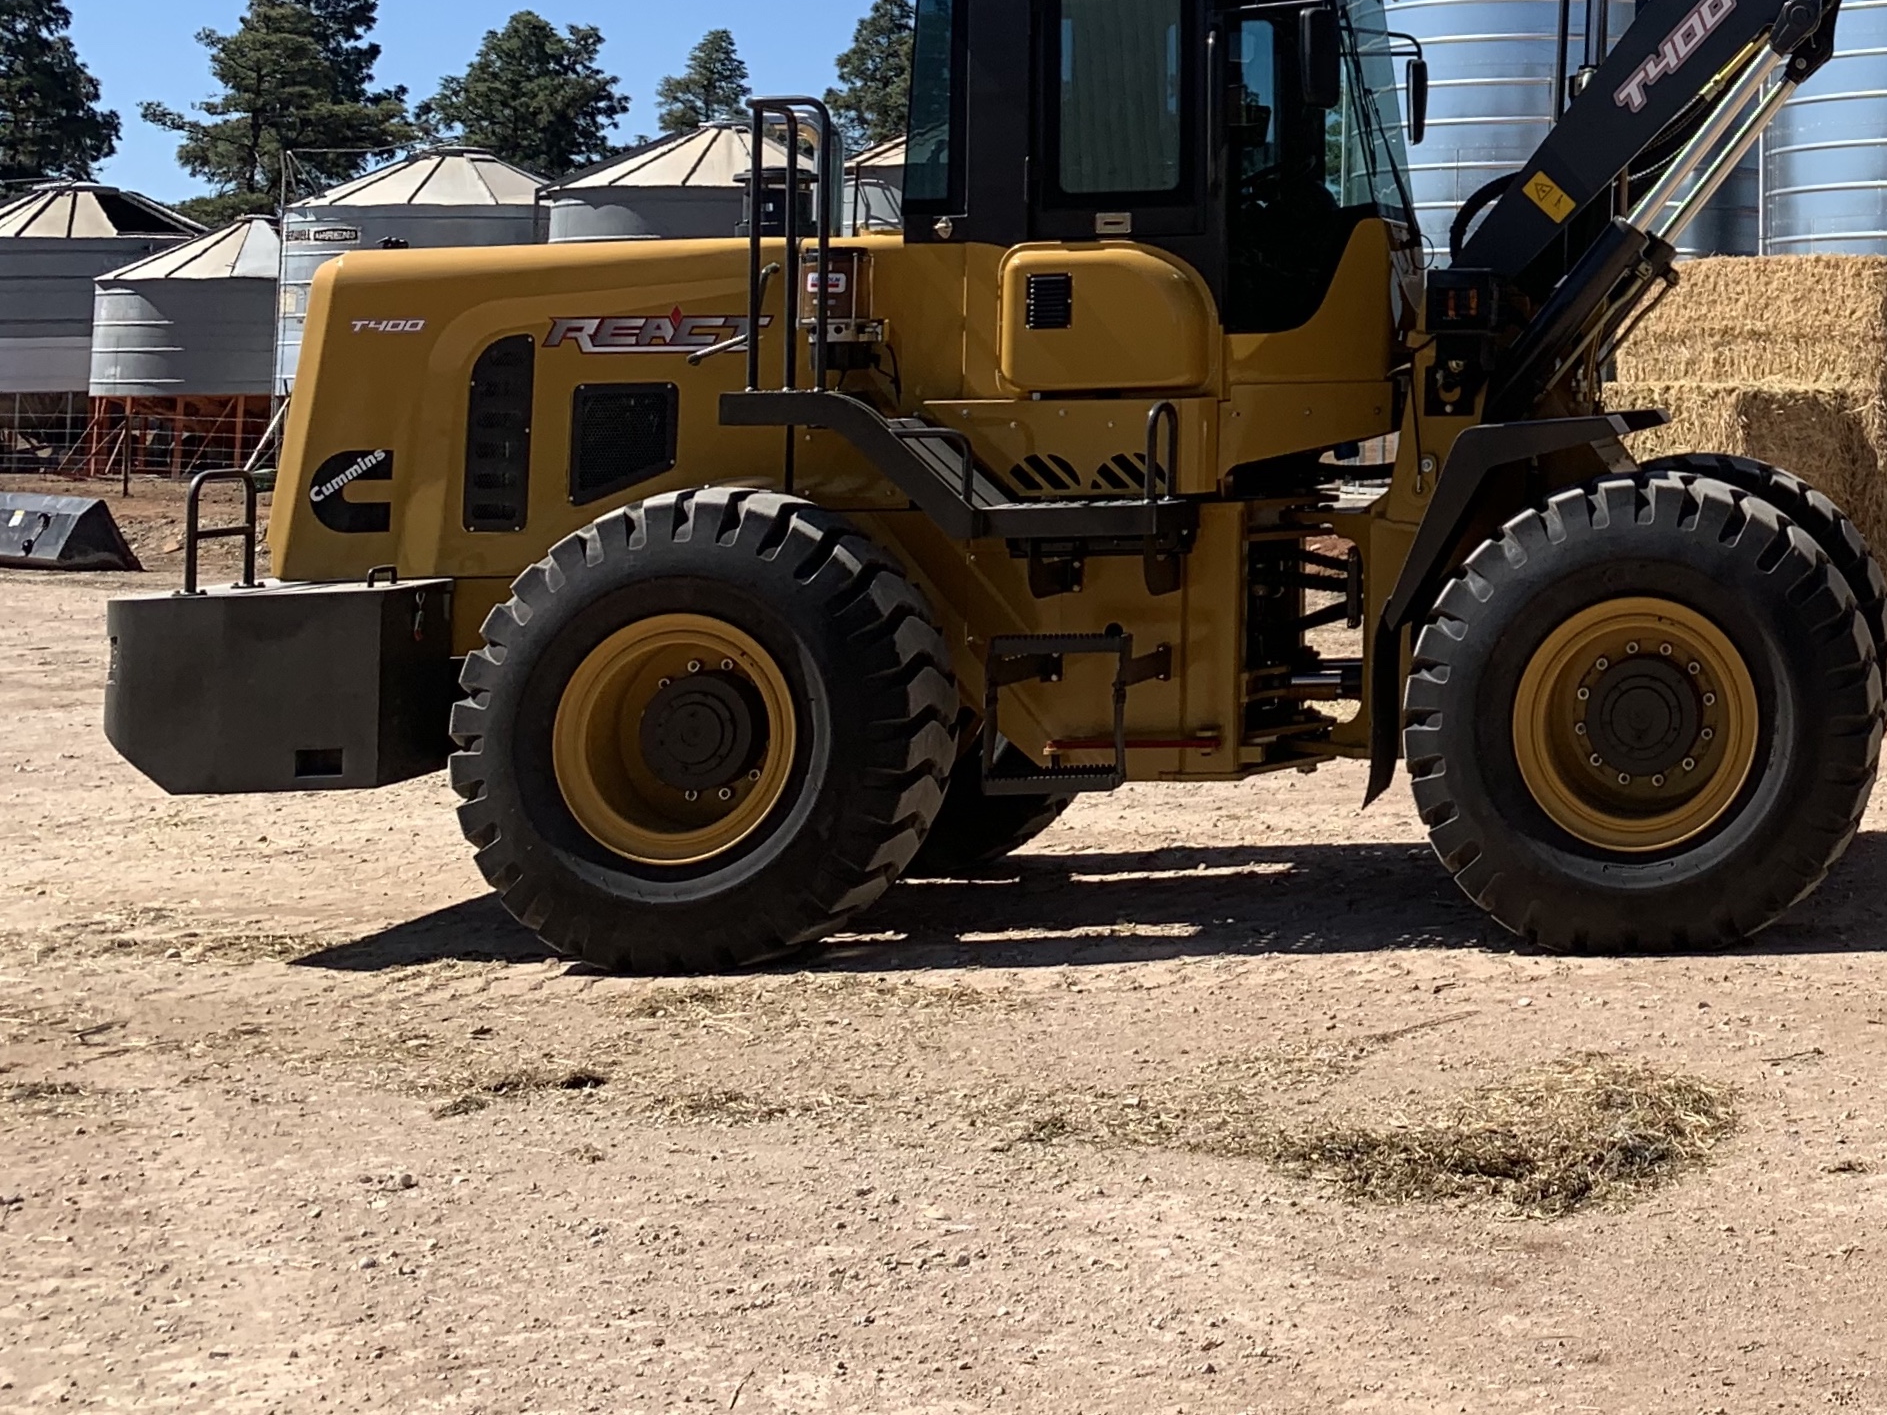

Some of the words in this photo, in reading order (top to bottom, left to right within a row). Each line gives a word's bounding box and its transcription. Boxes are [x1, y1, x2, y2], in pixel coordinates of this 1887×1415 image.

[351, 319, 426, 332] T400
[541, 315, 774, 354] REACT
[309, 449, 386, 502] Cummins
